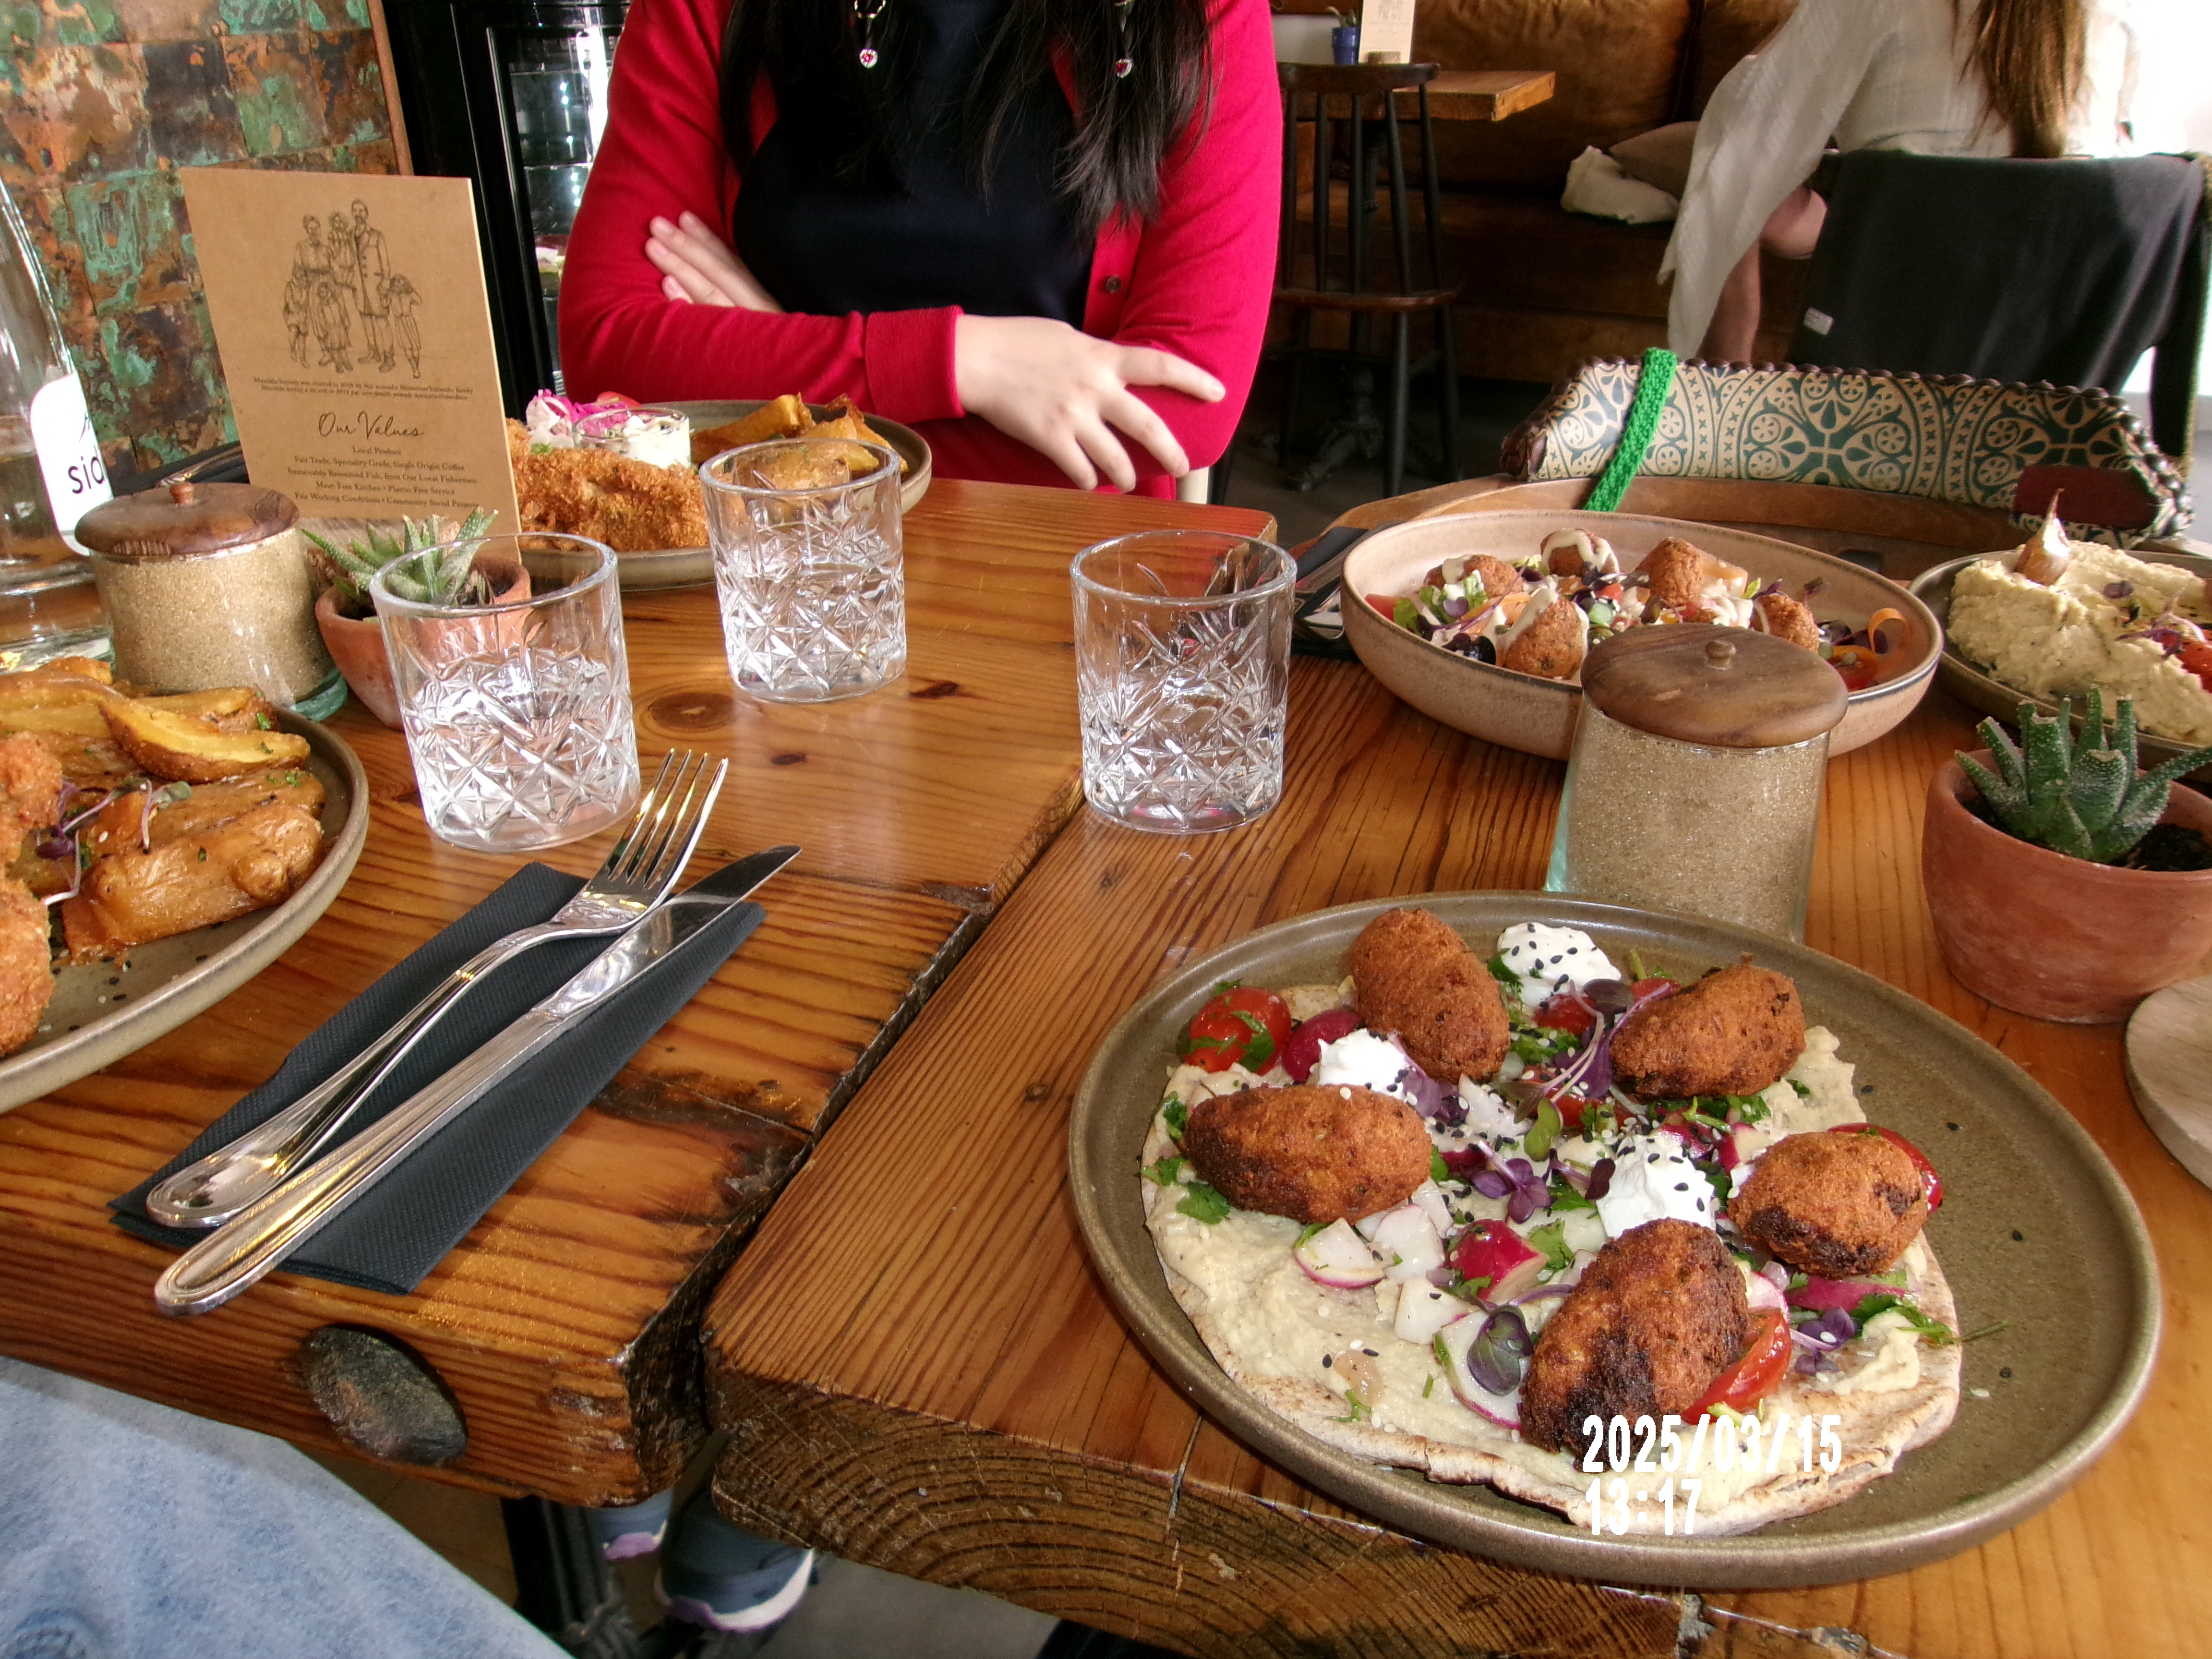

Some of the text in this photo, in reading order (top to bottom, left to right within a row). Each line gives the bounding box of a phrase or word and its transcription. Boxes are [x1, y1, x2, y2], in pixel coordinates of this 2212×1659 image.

[319, 411, 424, 439] Our Values
[393, 460, 414, 469] Single
[417, 461, 440, 470] Origin
[442, 462, 464, 470] Coffee
[288, 467, 326, 478] Sustainably
[385, 472, 400, 481] from
[419, 474, 438, 482] Local
[440, 475, 477, 484] Fishermen
[430, 487, 455, 495] Service
[310, 493, 340, 503] Working
[342, 495, 380, 503] Conditions
[386, 497, 427, 507] Community
[452, 500, 479, 509] Projects
